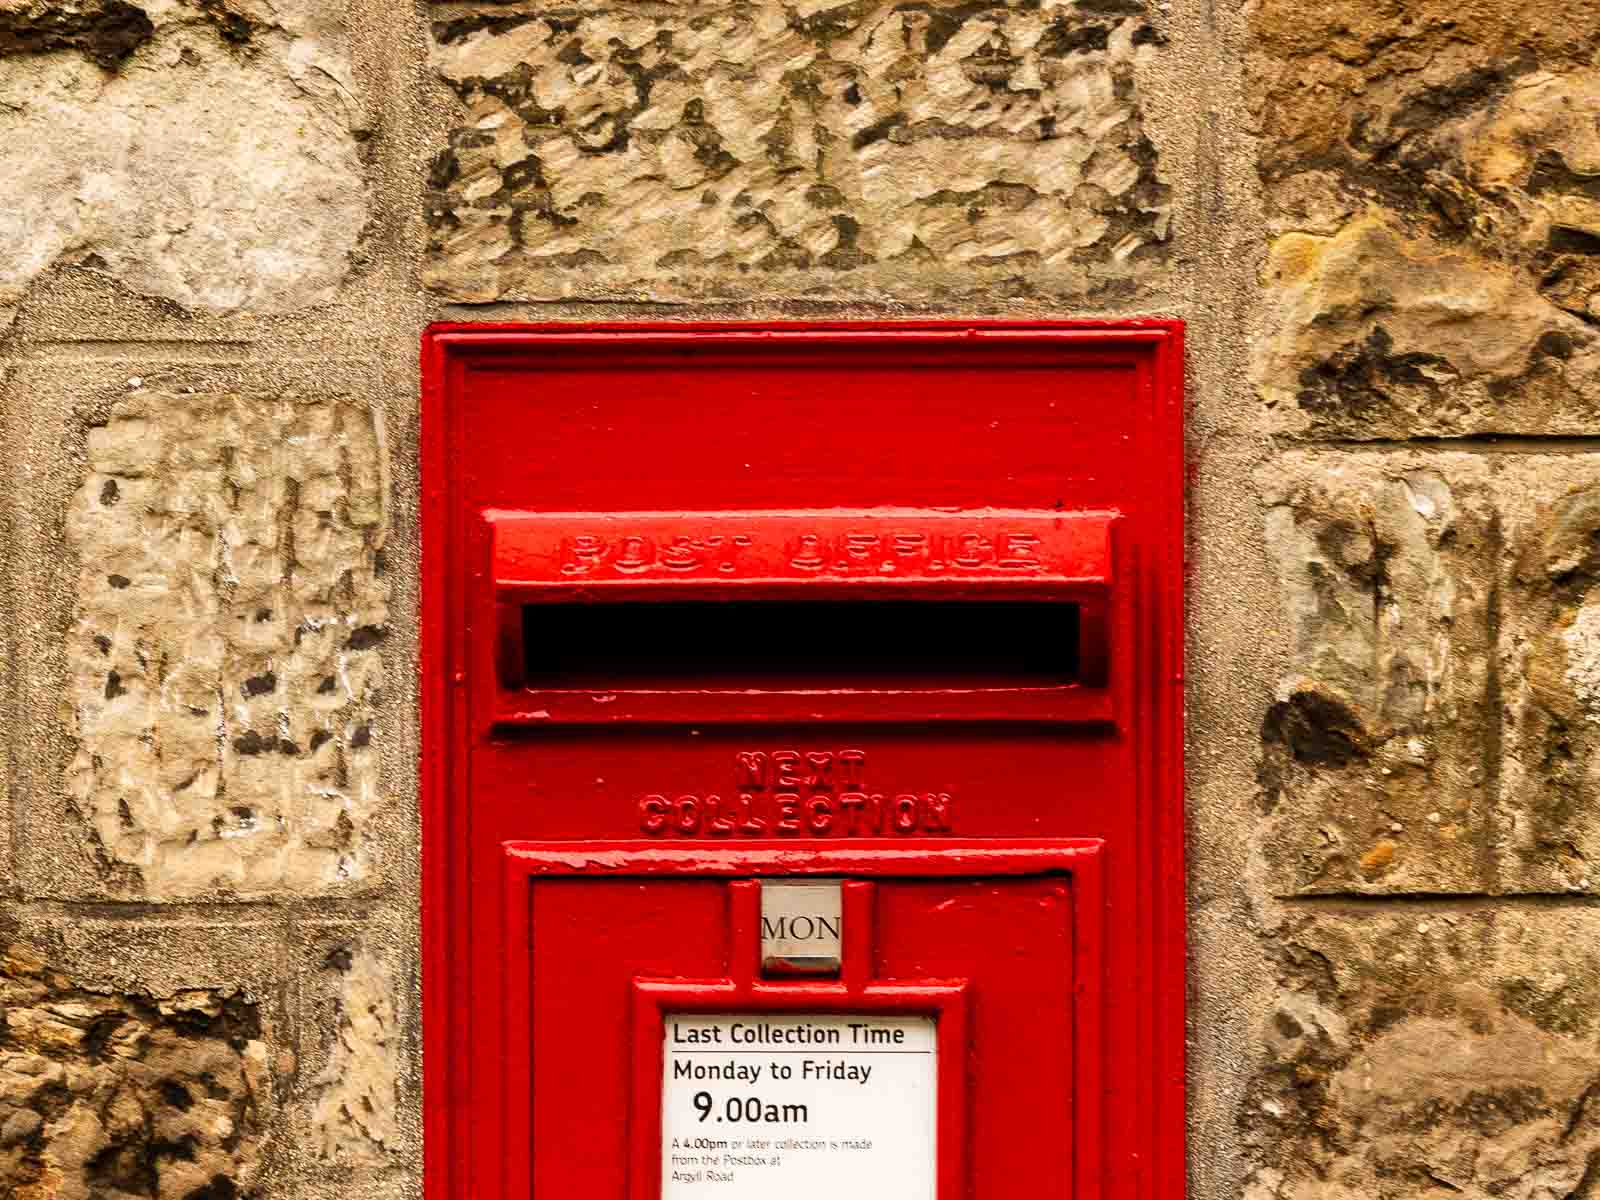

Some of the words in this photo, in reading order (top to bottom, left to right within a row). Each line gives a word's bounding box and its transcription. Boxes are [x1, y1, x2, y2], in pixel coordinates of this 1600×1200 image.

[560, 534, 754, 576] POST
[790, 531, 1042, 573] OFFICE
[735, 750, 867, 793] NEXT
[638, 792, 955, 836] COLLECTION
[761, 915, 841, 940] MON
[673, 1023, 722, 1044] Last
[730, 1023, 840, 1044] Collection
[848, 1024, 905, 1044] Time
[673, 1060, 761, 1084] Monday
[771, 1062, 792, 1080] to
[802, 1060, 872, 1084] Friday
[693, 1091, 808, 1123] 9.00am
[672, 1138, 680, 1149] A
[683, 1138, 728, 1151] 4.00pm
[731, 1140, 743, 1150] or
[746, 1138, 770, 1150] later
[775, 1138, 826, 1150] collection
[841, 1138, 872, 1150] made
[672, 1154, 699, 1166] from
[701, 1154, 720, 1166] the
[723, 1154, 766, 1166] Postbox
[770, 1154, 781, 1166] at
[706, 1170, 735, 1182] Road
